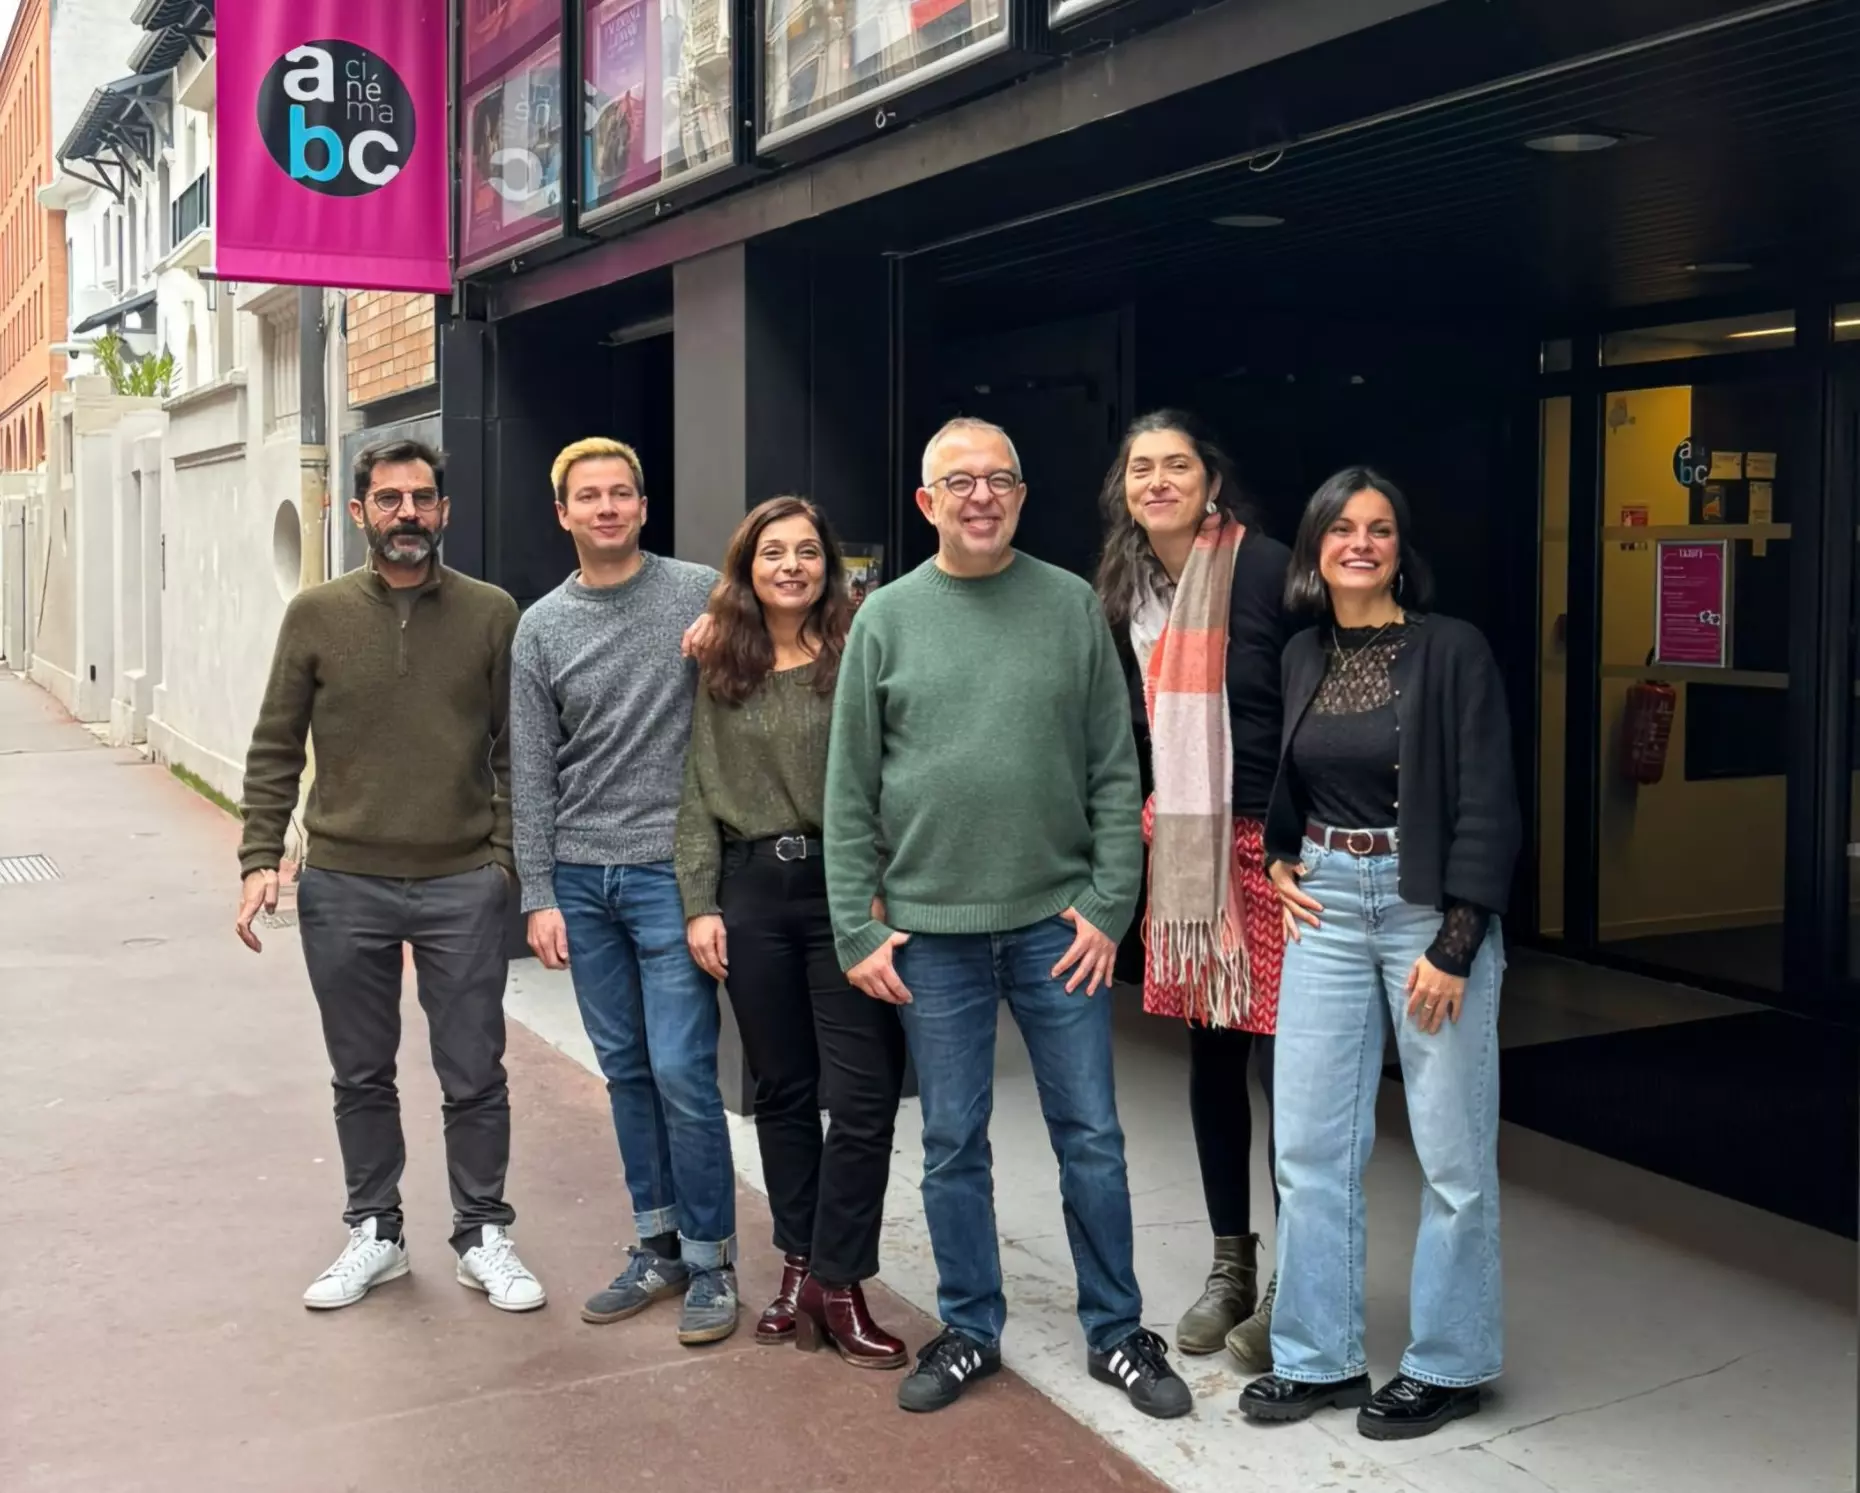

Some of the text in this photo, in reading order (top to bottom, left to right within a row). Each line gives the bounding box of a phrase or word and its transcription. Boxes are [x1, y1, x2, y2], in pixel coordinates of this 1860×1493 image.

[282, 44, 335, 102] a
[345, 53, 367, 80] ci
[346, 74, 382, 103] né
[346, 99, 394, 125] ma
[288, 104, 400, 186] bc
[1679, 440, 1692, 459] a
[1679, 460, 1708, 485] bc
